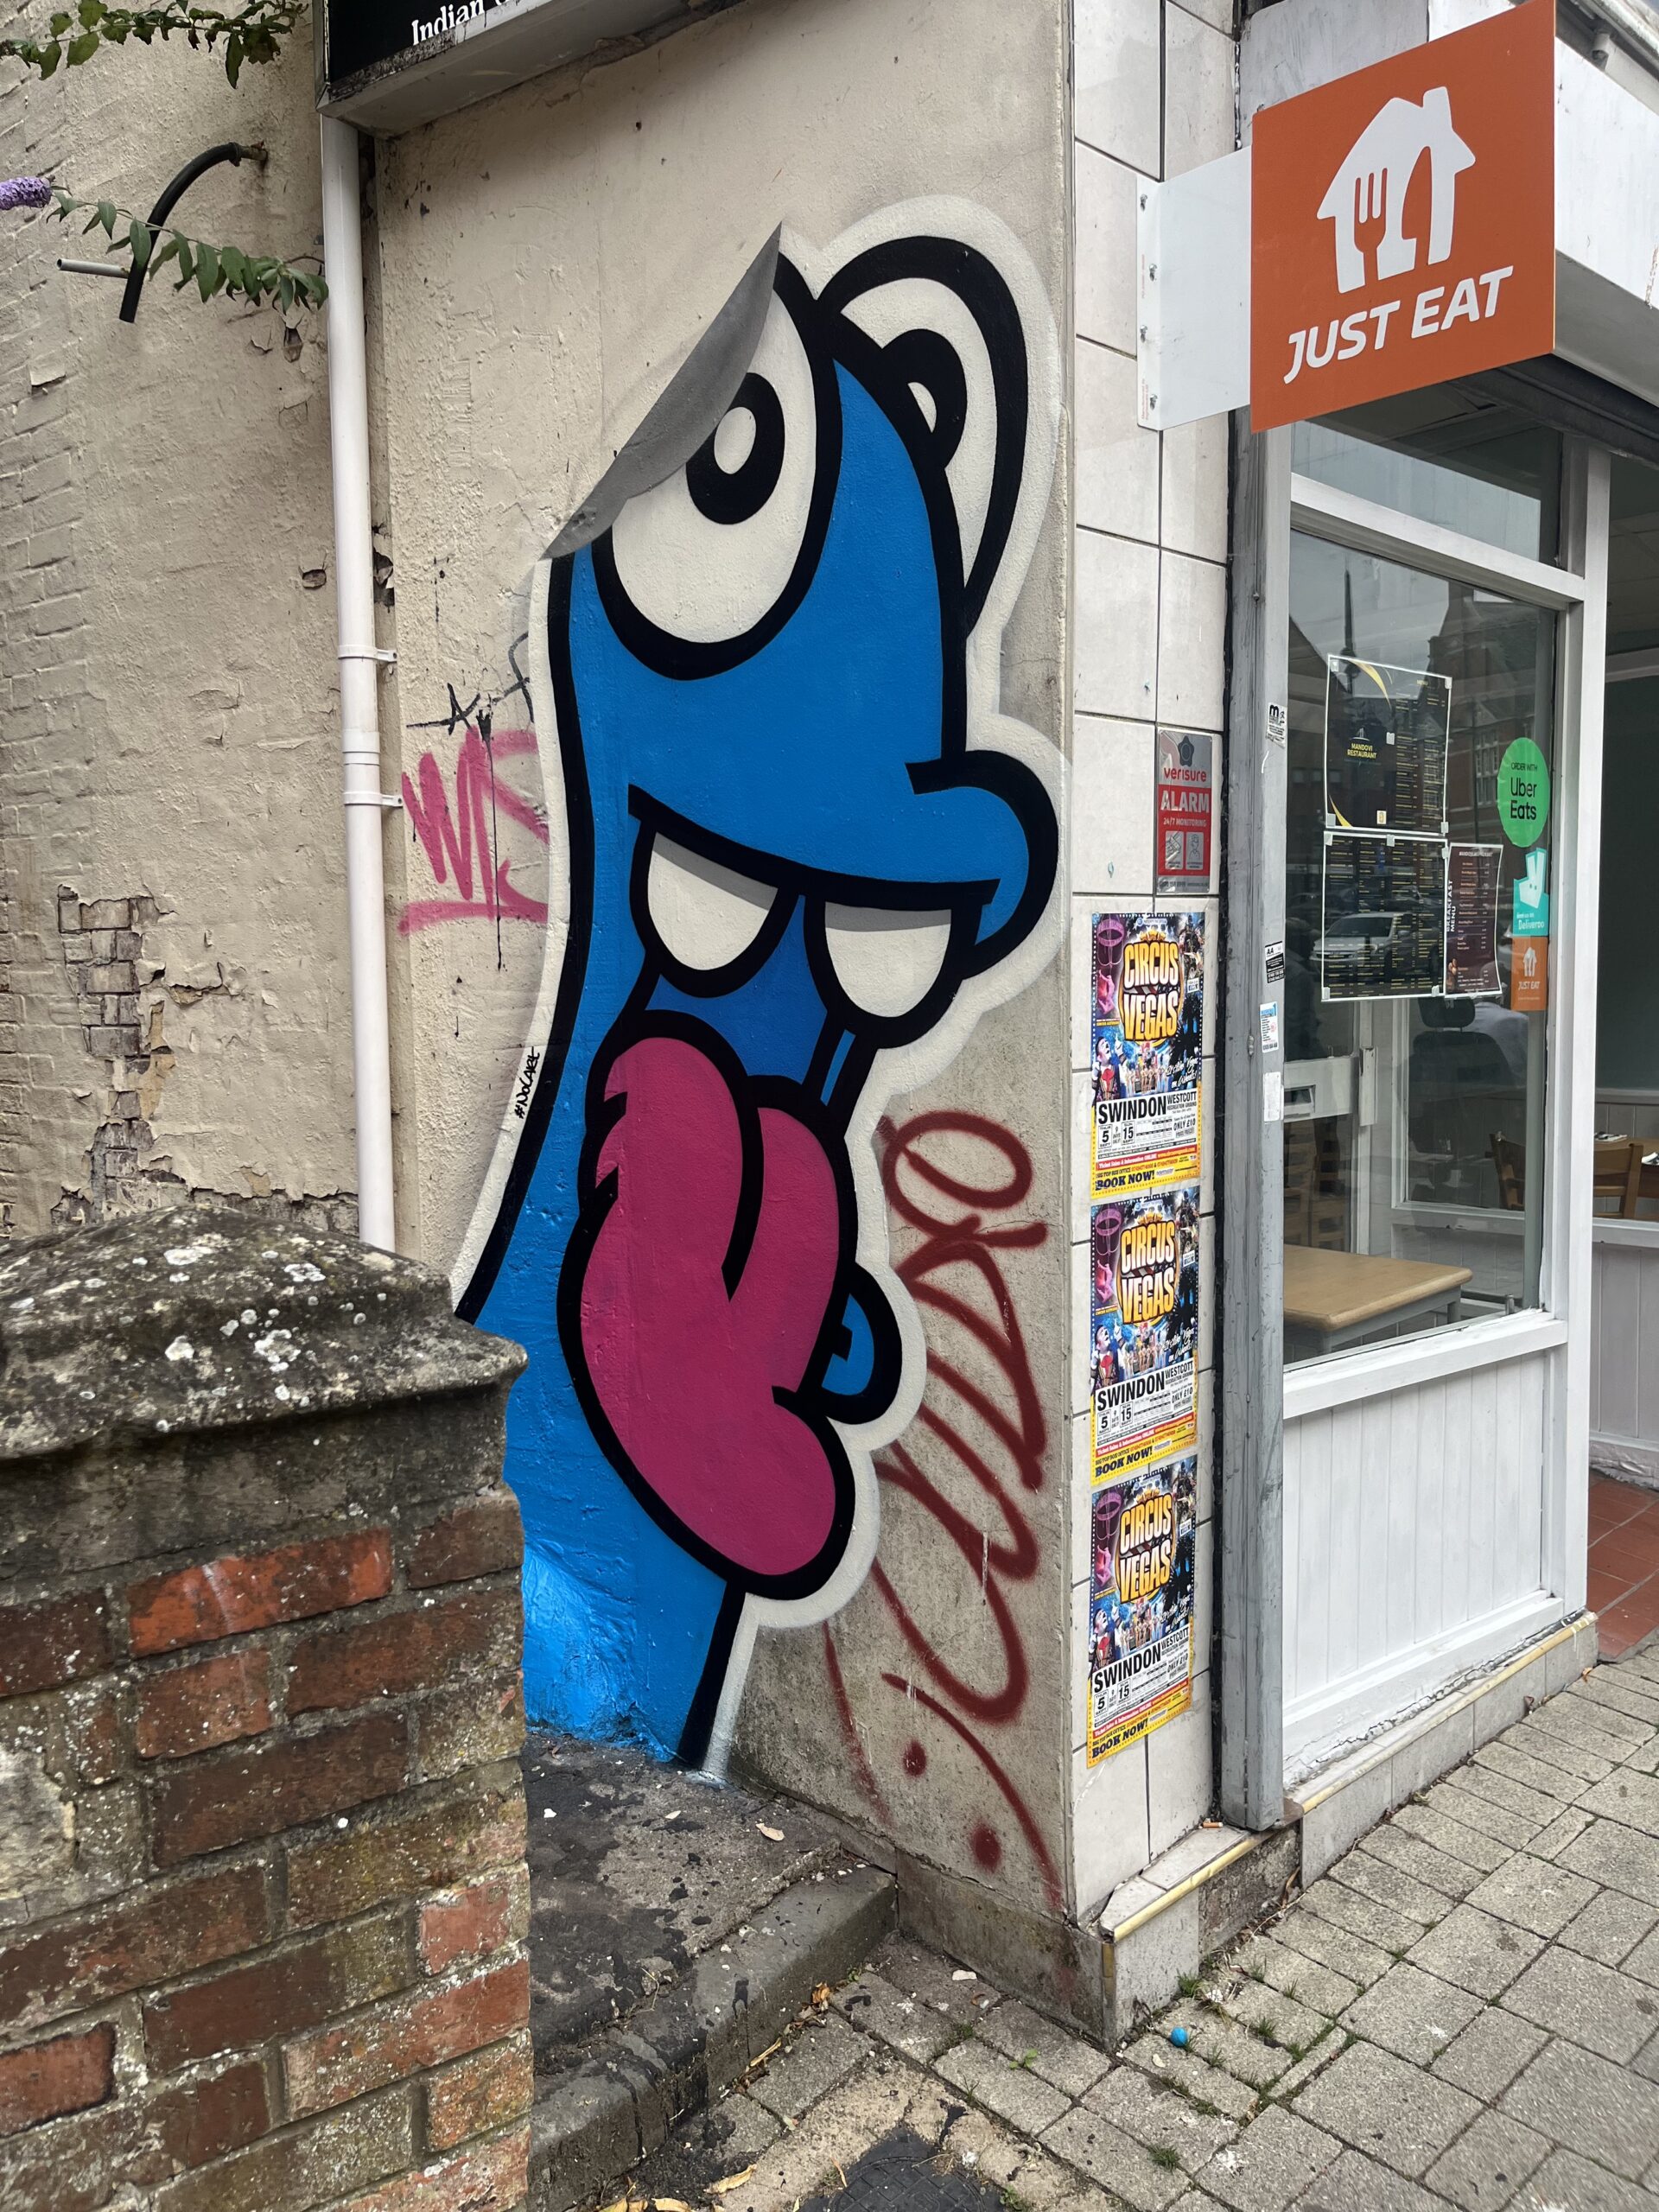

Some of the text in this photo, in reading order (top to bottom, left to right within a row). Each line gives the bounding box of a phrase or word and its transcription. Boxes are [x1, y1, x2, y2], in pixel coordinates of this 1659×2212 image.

[411, 0, 485, 45] Indian
[1283, 265, 1514, 385] JUST EAT
[1348, 749, 1377, 759] RESTAURANT
[1163, 767, 1207, 782] verisure
[1511, 762, 1526, 771] ORDER
[1511, 777, 1537, 797] Uber
[1161, 790, 1209, 813] ALARM
[1510, 800, 1536, 820] Eats
[1163, 817, 1207, 827] 24/7 MONITORING
[1518, 920, 1544, 930] Deliveroo
[1124, 941, 1179, 988] CIRCUS
[1518, 981, 1530, 990] JUST
[1124, 990, 1179, 1041] VEGAS
[1167, 1091, 1197, 1105] WESTCOTT
[1098, 1096, 1166, 1124] SWINDON
[1124, 1127, 1133, 1139] 15
[1173, 1120, 1186, 1131] ONLY
[1186, 1118, 1196, 1127] £10
[1102, 1130, 1109, 1143] 5
[1096, 1176, 1126, 1191] BOOK
[1128, 1170, 1155, 1184] NOW!
[1121, 1220, 1176, 1273] CIRCUS
[1121, 1267, 1175, 1325] VEGAS
[1165, 1361, 1193, 1379] WESTCOTT
[1097, 1371, 1164, 1411] SWINDON
[1172, 1392, 1183, 1403] ONLY
[1101, 1416, 1108, 1428] 5
[1121, 1408, 1131, 1421] 15
[1096, 1446, 1152, 1477] BOOK NOW!
[1120, 1494, 1172, 1553] CIRCUS
[1120, 1540, 1171, 1604] VEGAS
[1161, 1627, 1189, 1650] WESTCOTT
[1094, 1643, 1161, 1693] SWINDON
[1119, 1685, 1129, 1699] 15
[1098, 1697, 1105, 1710] 5
[1092, 1735, 1120, 1758] BOOK
[1122, 1718, 1148, 1741] NOW!
